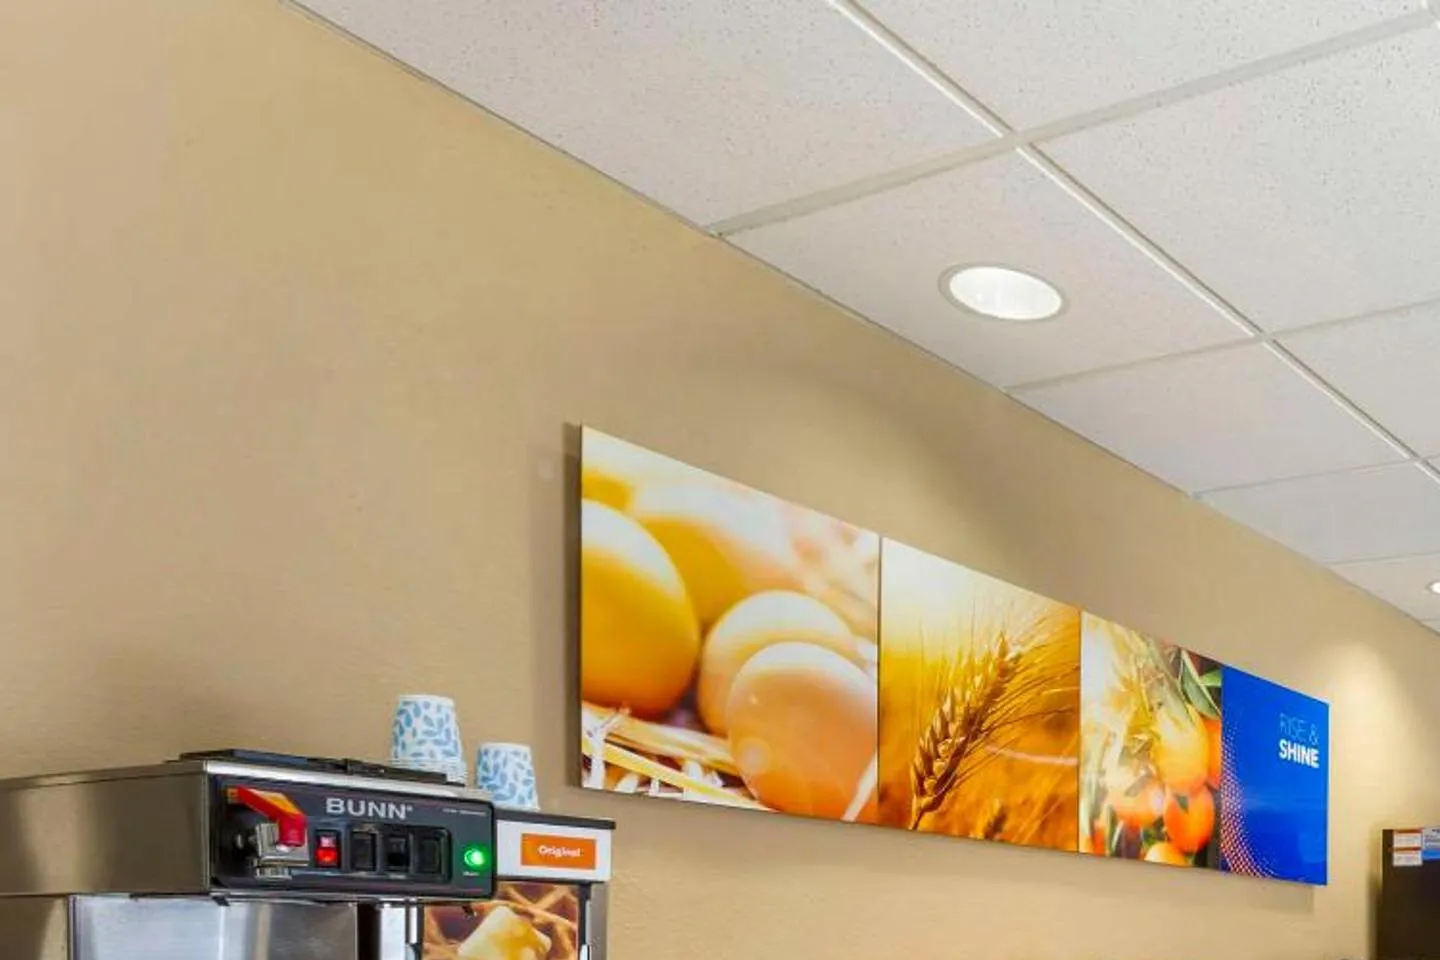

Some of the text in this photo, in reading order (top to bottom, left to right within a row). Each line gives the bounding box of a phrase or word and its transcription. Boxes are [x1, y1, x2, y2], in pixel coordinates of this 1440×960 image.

[1280, 712, 1320, 746] RISE &
[1279, 738, 1320, 769] SHINE
[326, 797, 409, 820] BUNN
[538, 844, 583, 858] Original
